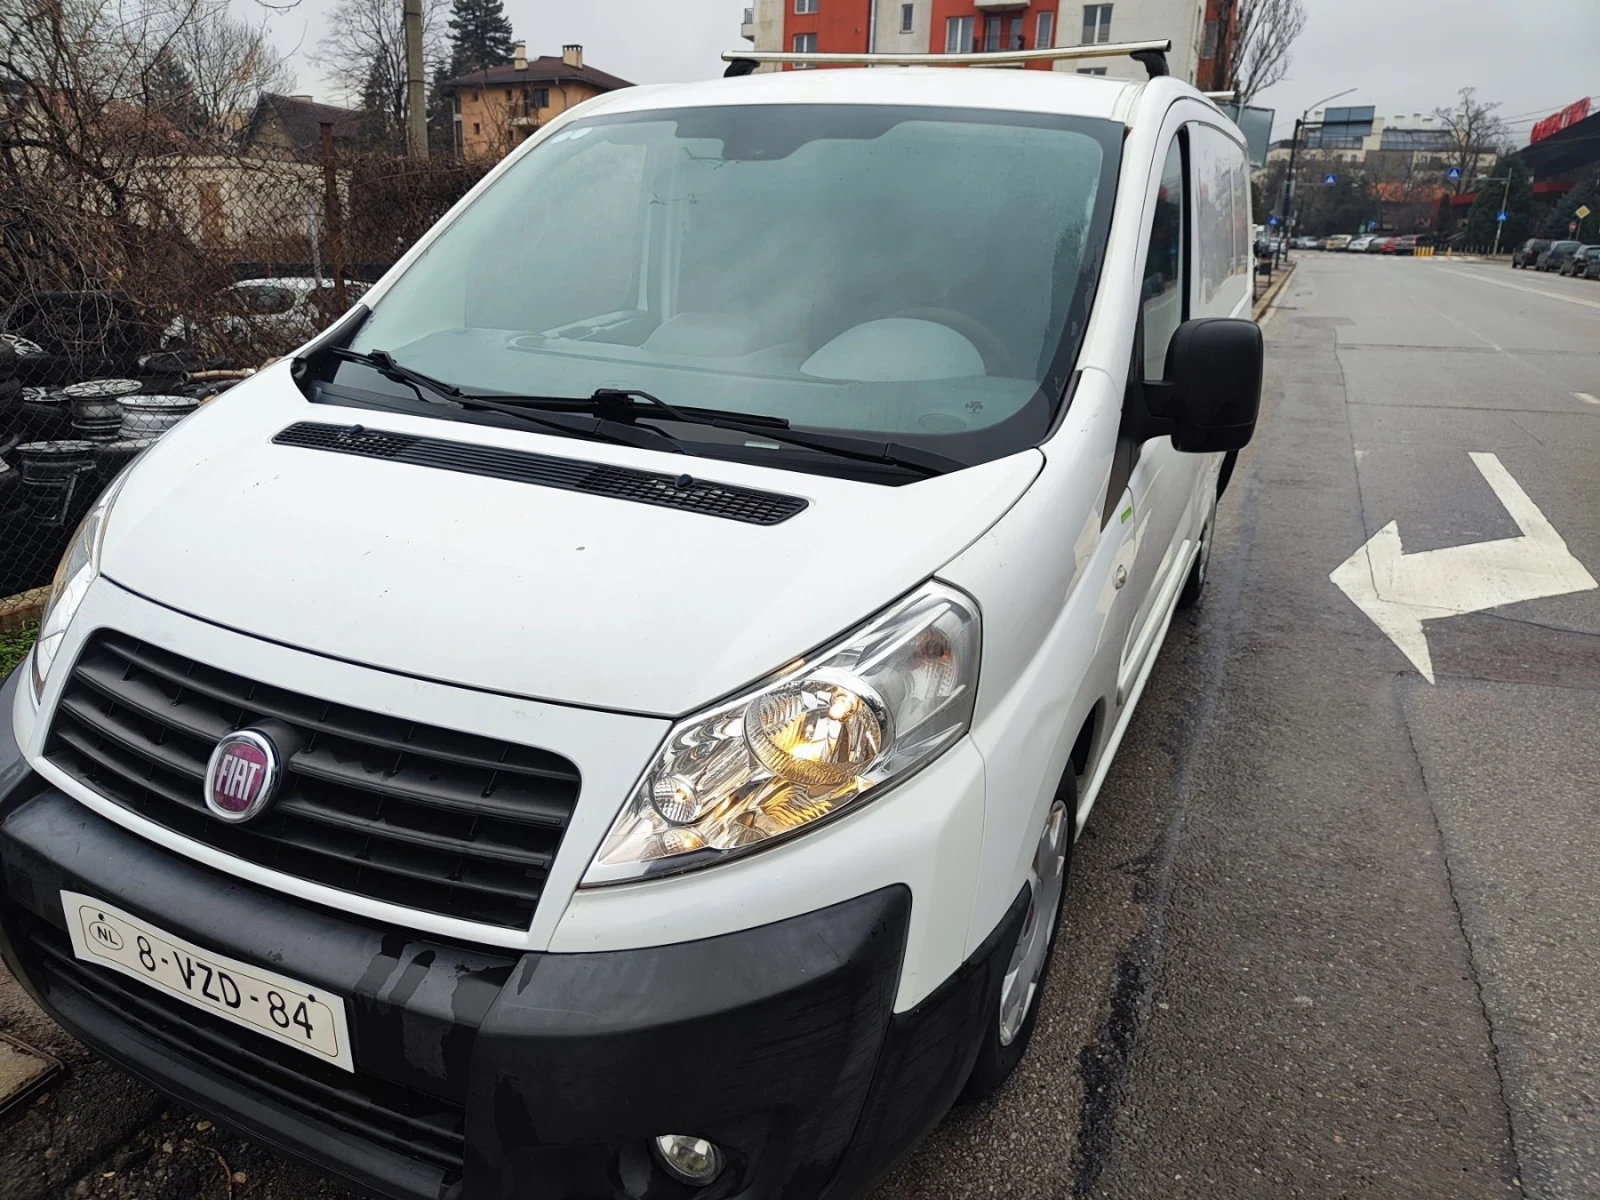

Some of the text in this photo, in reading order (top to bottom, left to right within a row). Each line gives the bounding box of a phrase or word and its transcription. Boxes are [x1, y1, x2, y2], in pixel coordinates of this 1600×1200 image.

[216, 754, 261, 801] FIAT
[97, 926, 119, 946] NL
[136, 935, 314, 1040] 8-VZD-84
